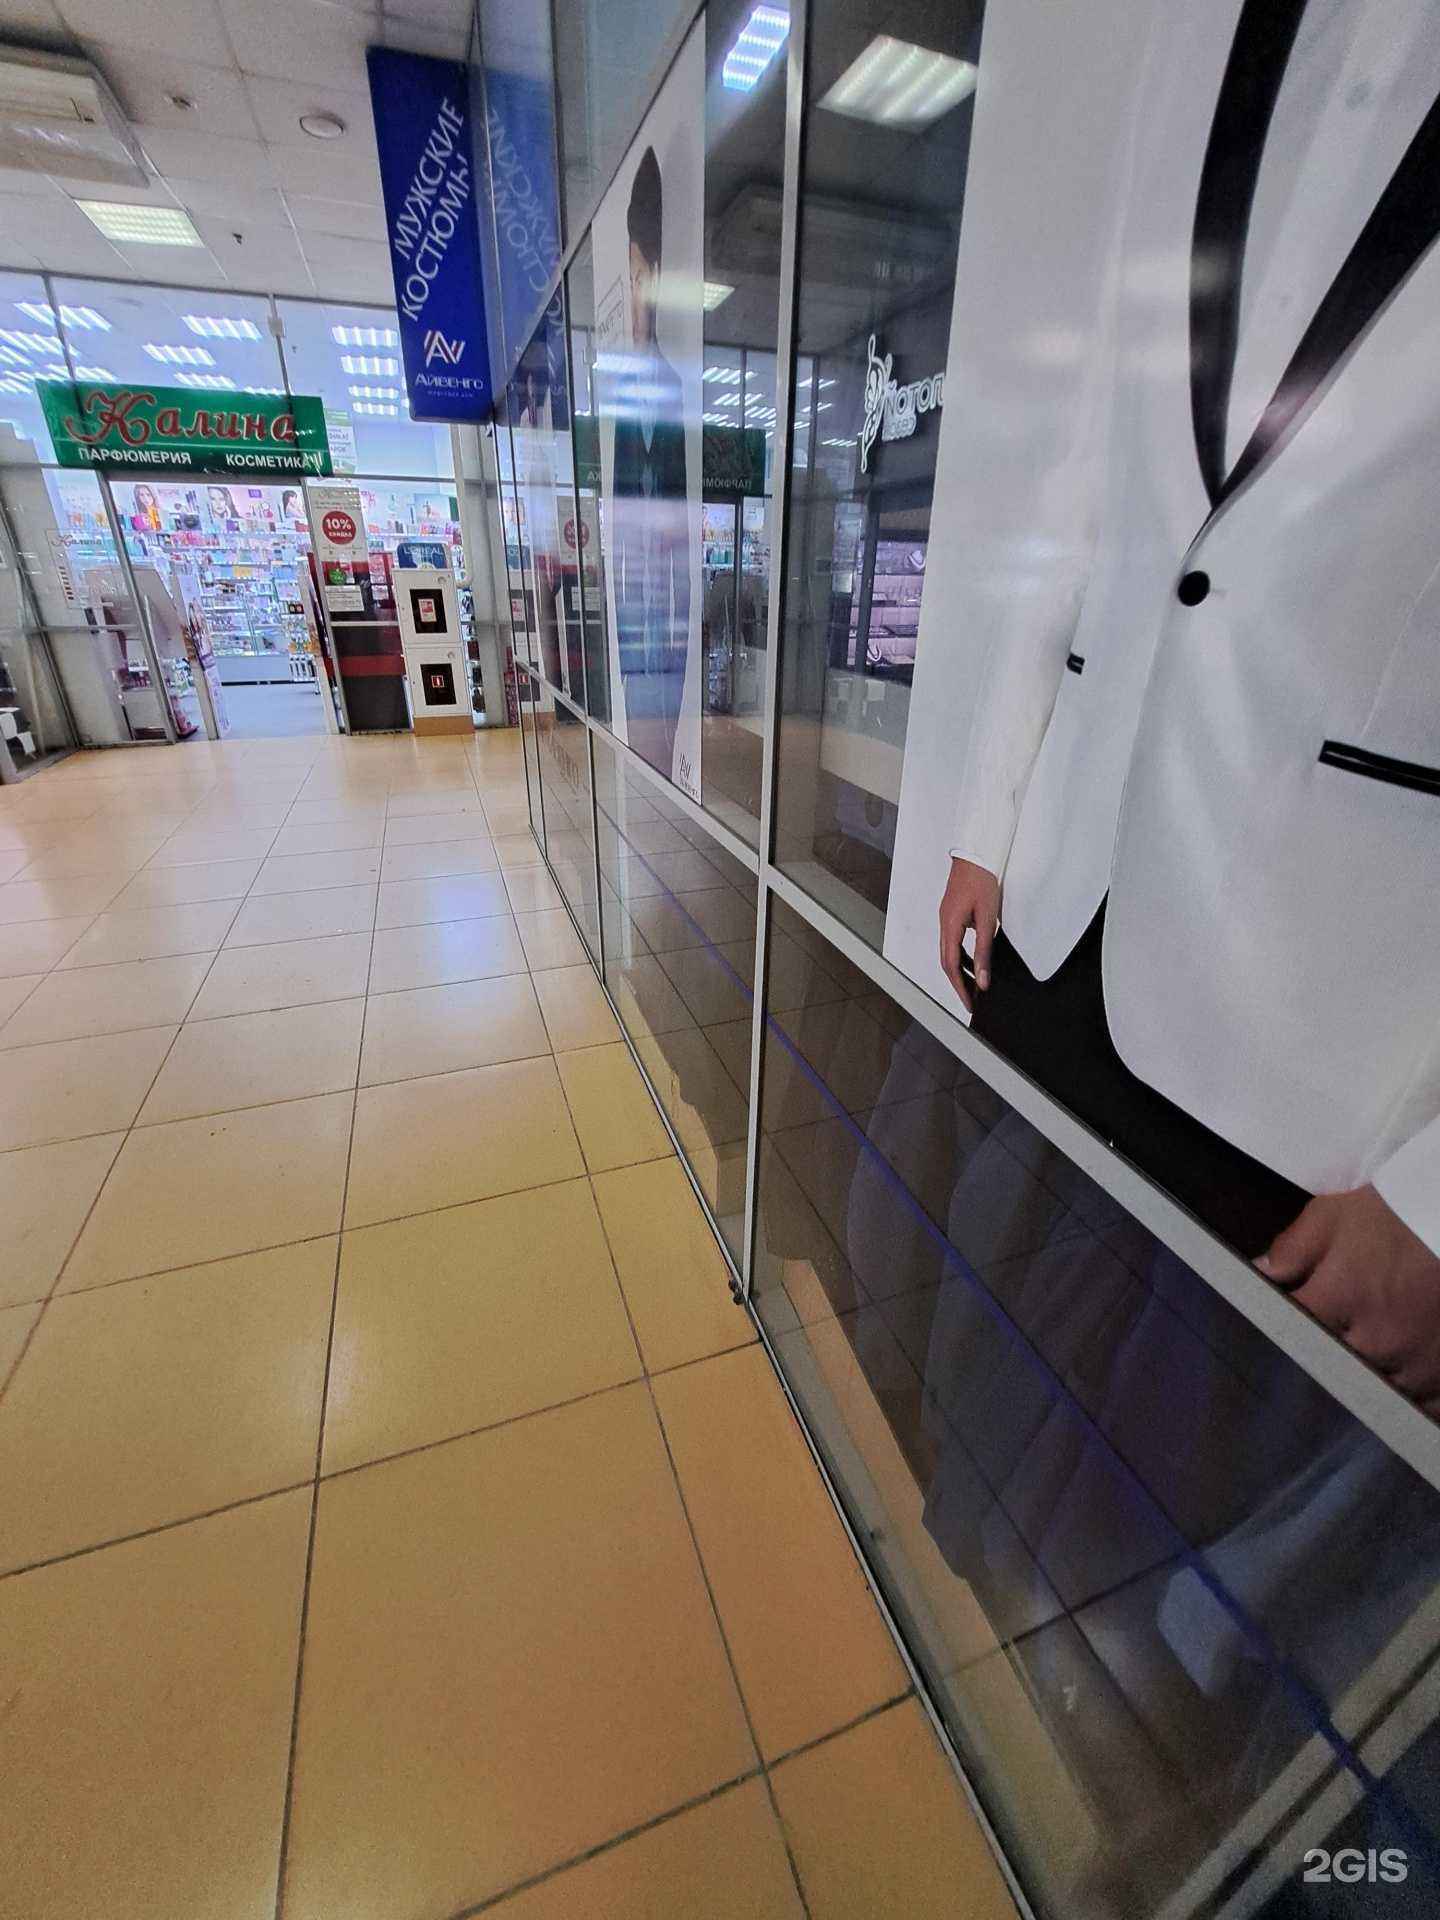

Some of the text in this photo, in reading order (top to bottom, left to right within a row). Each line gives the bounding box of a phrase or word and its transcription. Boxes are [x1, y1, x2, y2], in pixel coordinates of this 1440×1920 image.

[394, 97, 466, 260] МУЖСКИЕ
[400, 153, 470, 322] КОСТЮМЫ
[64, 391, 296, 445] Калина
[78, 447, 313, 470] ПАРФЮМЕРИЯ КОСМЕТИКА
[325, 517, 352, 530] 10%
